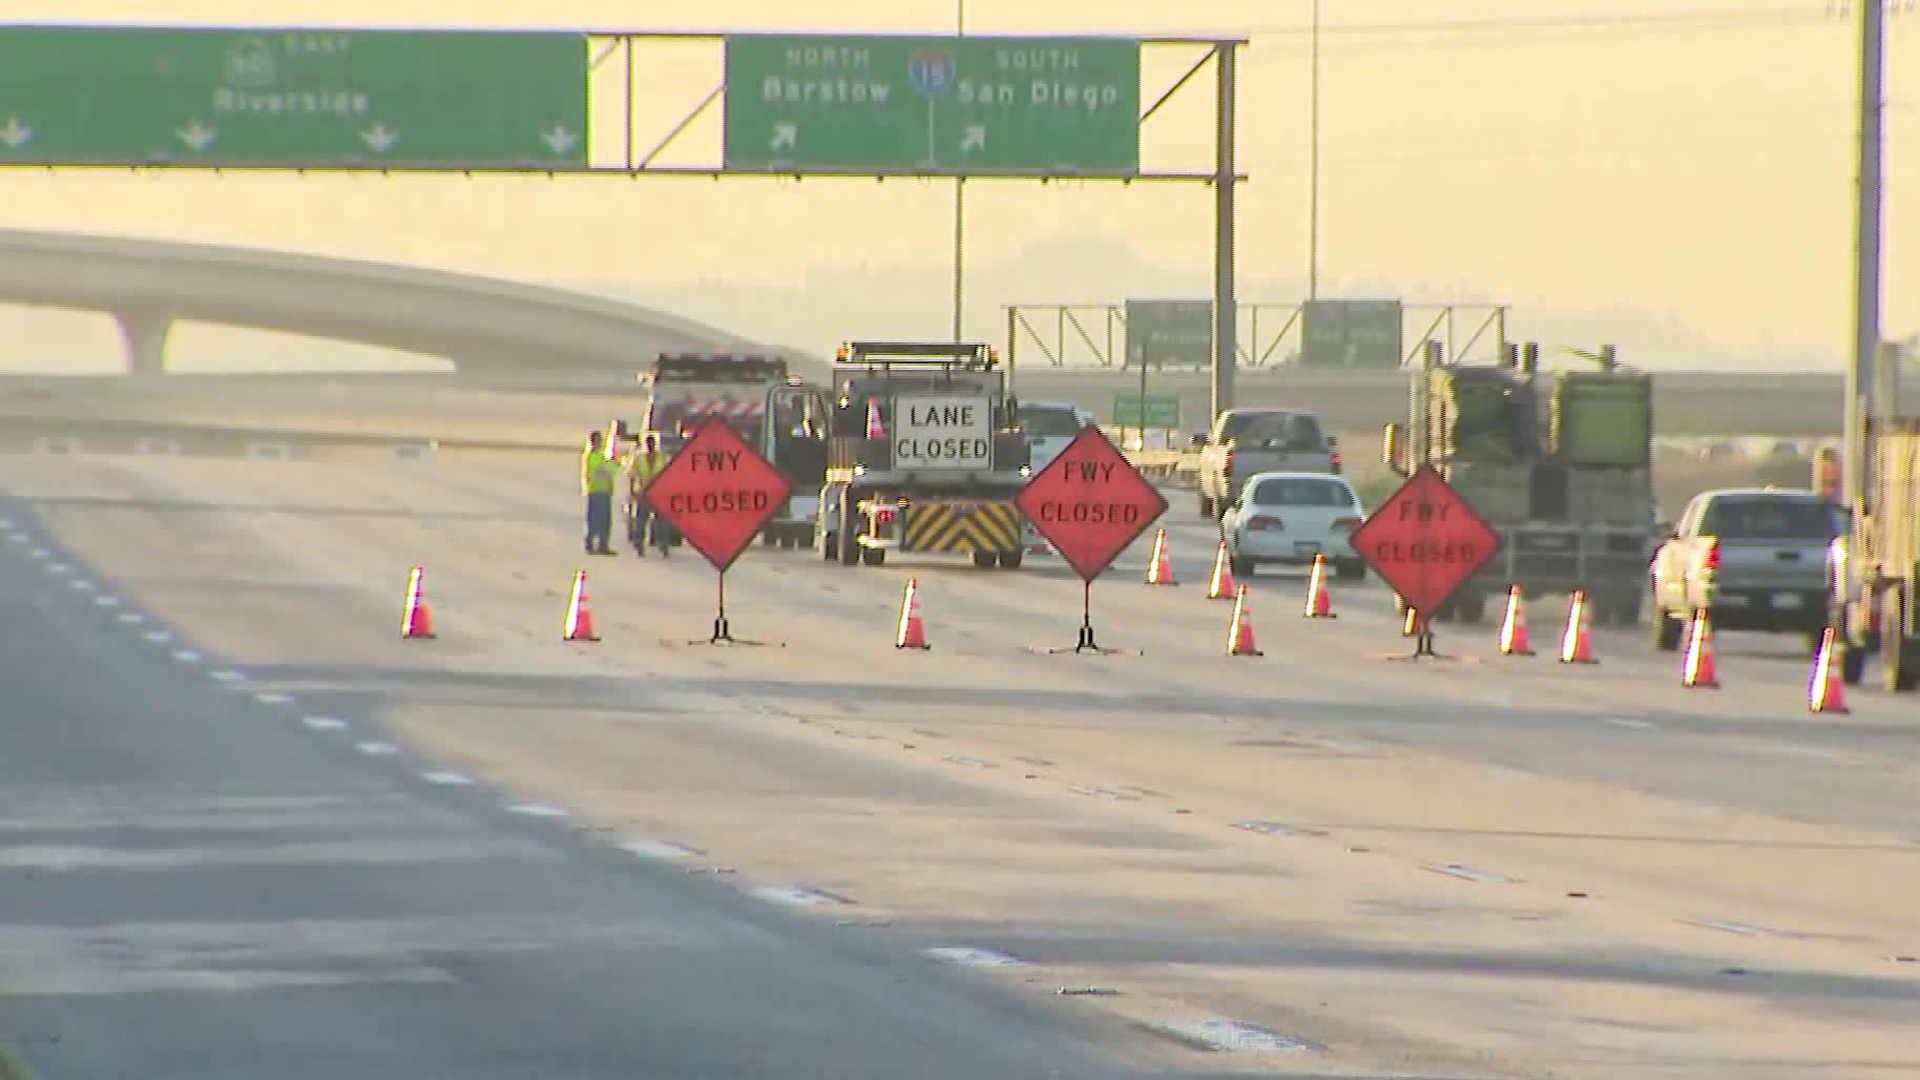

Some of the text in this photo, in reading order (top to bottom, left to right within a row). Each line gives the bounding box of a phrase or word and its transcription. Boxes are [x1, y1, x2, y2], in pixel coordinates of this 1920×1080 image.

[286, 34, 352, 51] EAST
[786, 47, 870, 67] NORTH
[996, 49, 1079, 68] SOUTH
[921, 64, 945, 85] 15
[763, 76, 891, 102] Barstow
[957, 79, 1118, 110] San Diego
[213, 88, 369, 113] Riverside
[910, 404, 975, 427] LANE
[898, 437, 988, 459] CLOSED
[690, 450, 741, 472] FWY
[1064, 461, 1116, 483] FWY
[669, 490, 768, 514] CLOSED
[1040, 502, 1139, 524] CLOSED
[1399, 501, 1449, 522] FWY
[1376, 540, 1475, 564] CLOSED
